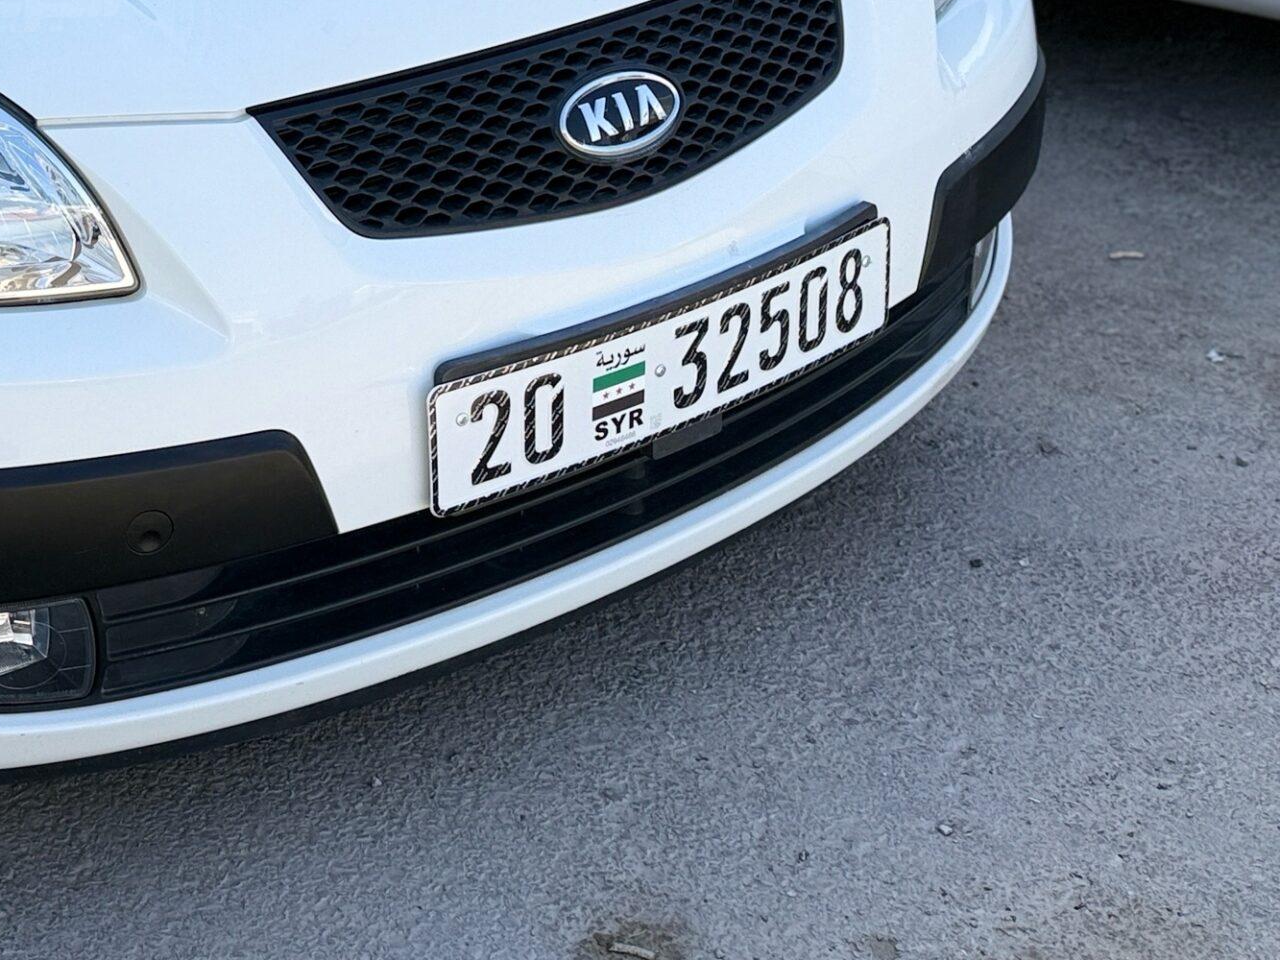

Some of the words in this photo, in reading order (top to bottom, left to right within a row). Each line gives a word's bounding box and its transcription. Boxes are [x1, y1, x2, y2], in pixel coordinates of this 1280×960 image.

[578, 84, 667, 142] KIA
[470, 373, 564, 485] 20
[673, 248, 863, 409] 32508
[596, 344, 646, 371] سورية
[595, 408, 643, 441] SYR
